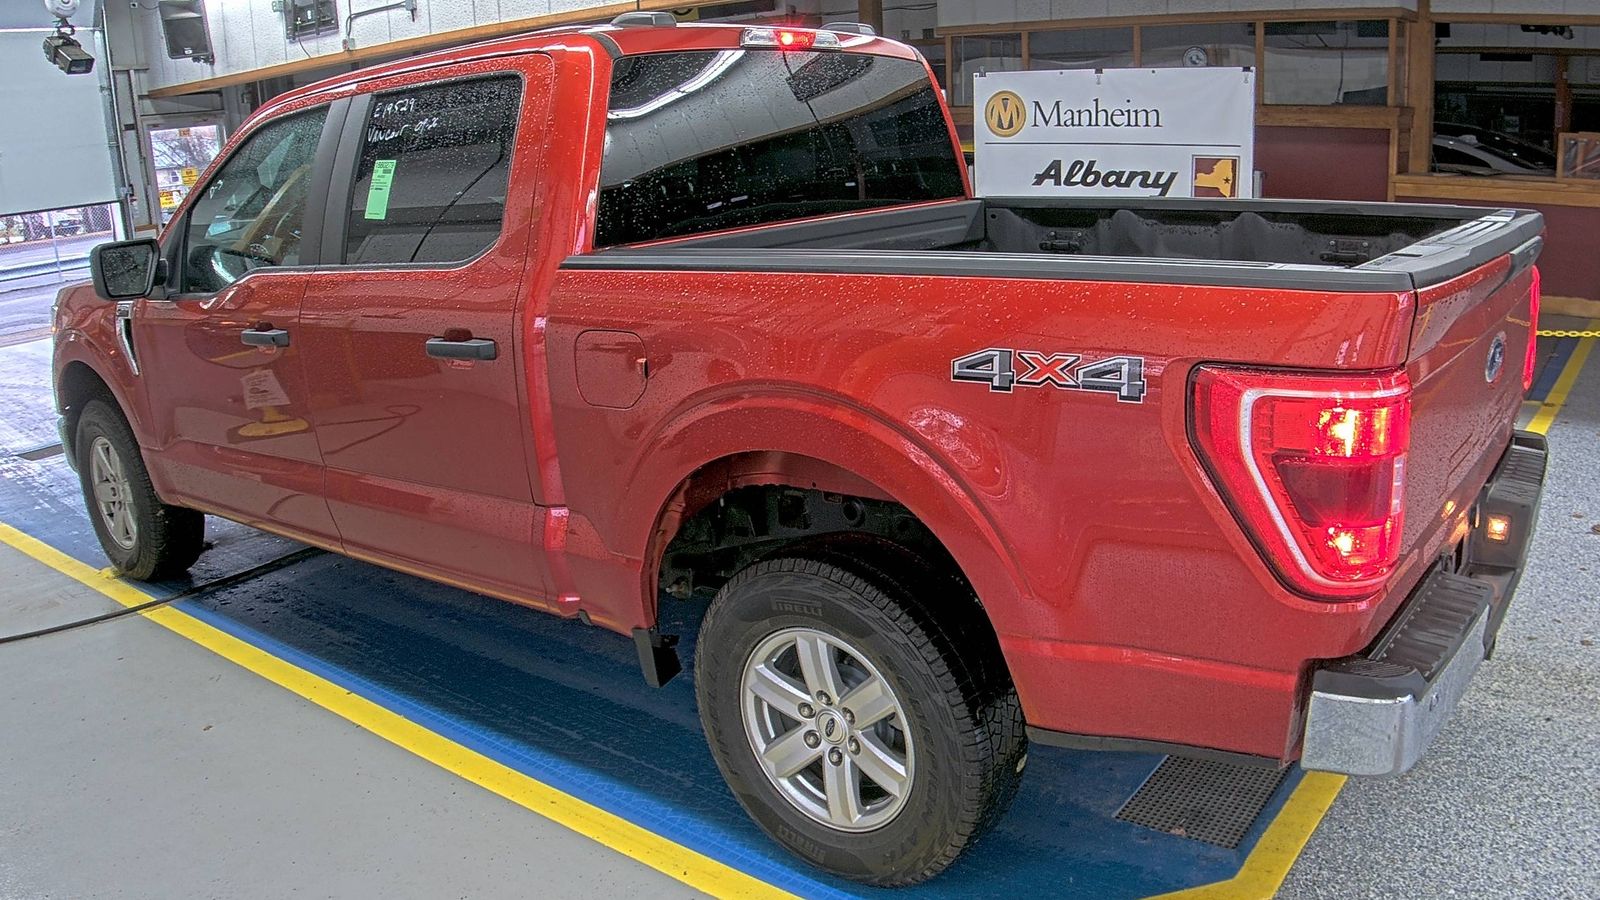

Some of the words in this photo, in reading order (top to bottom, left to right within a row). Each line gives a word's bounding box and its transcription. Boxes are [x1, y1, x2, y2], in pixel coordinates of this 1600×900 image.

[1031, 98, 1163, 128] Manheim
[1031, 159, 1178, 197] Albany
[771, 597, 824, 617] PIRELLI
